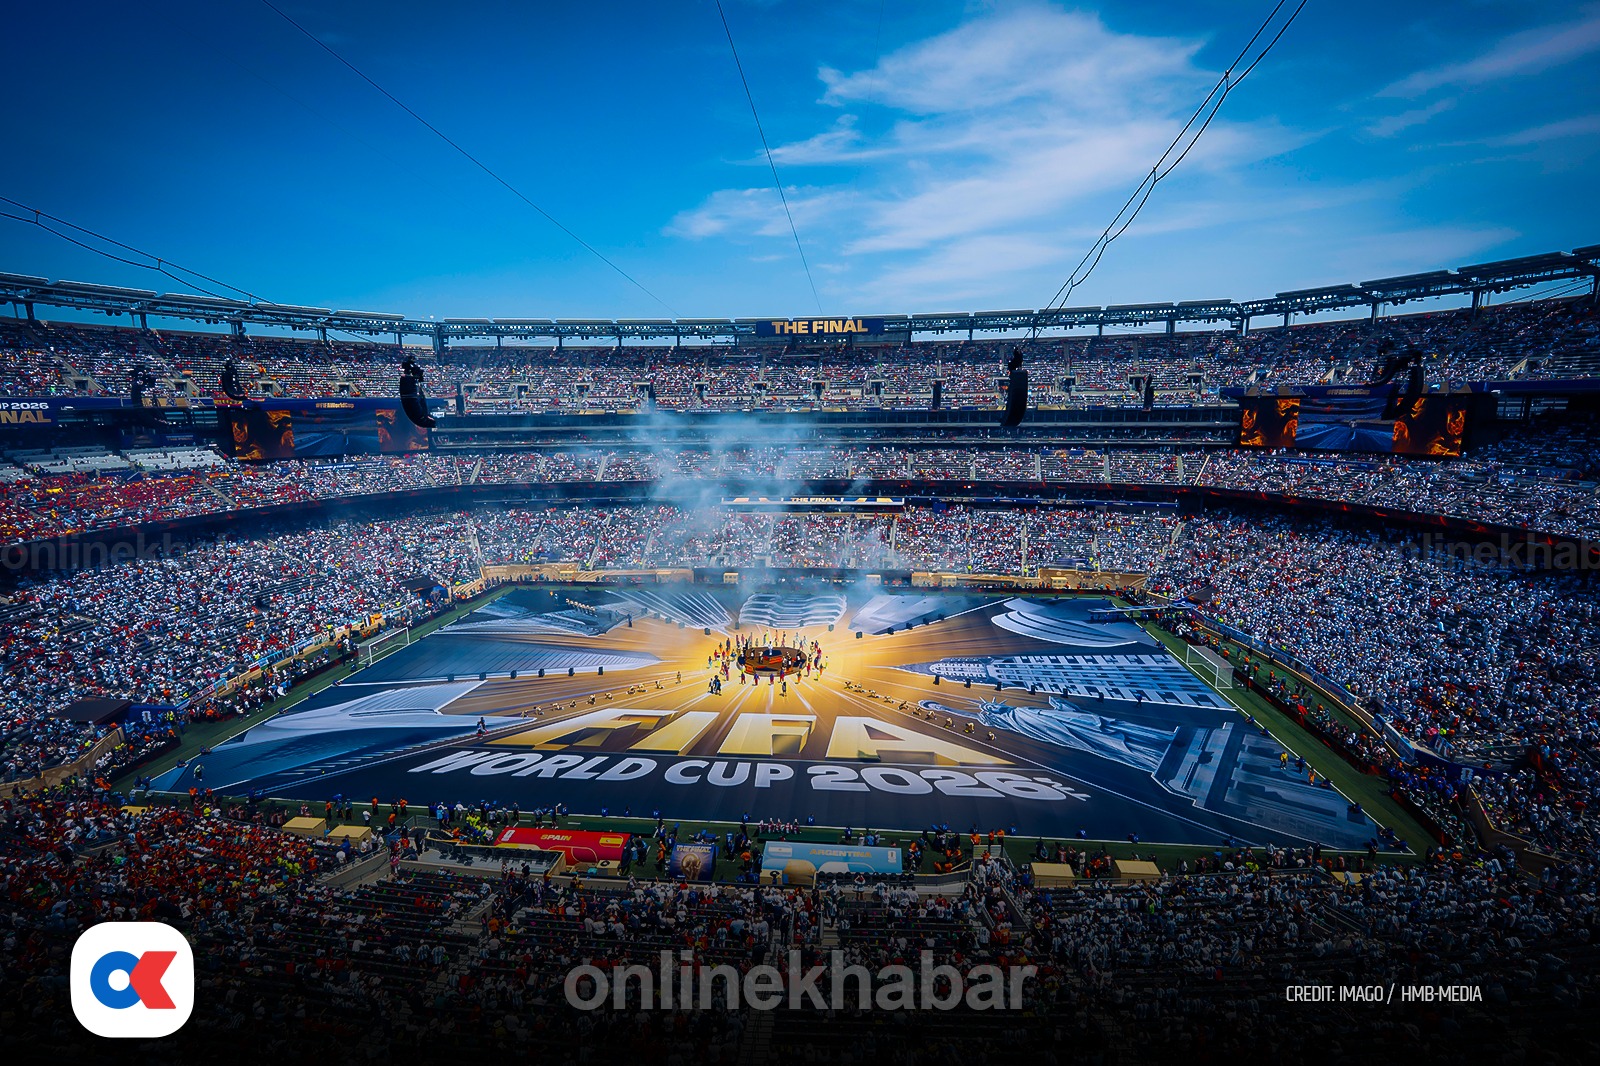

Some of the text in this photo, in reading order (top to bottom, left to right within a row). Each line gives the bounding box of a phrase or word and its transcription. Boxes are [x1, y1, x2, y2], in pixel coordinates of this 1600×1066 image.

[771, 319, 869, 335] THE FINAL
[10, 402, 50, 410] 2026
[483, 707, 1016, 766] FIFA
[408, 750, 656, 781] WORLD
[664, 758, 794, 788] CUP
[540, 833, 572, 842] SPAIN
[809, 849, 872, 858] ARGENTINA
